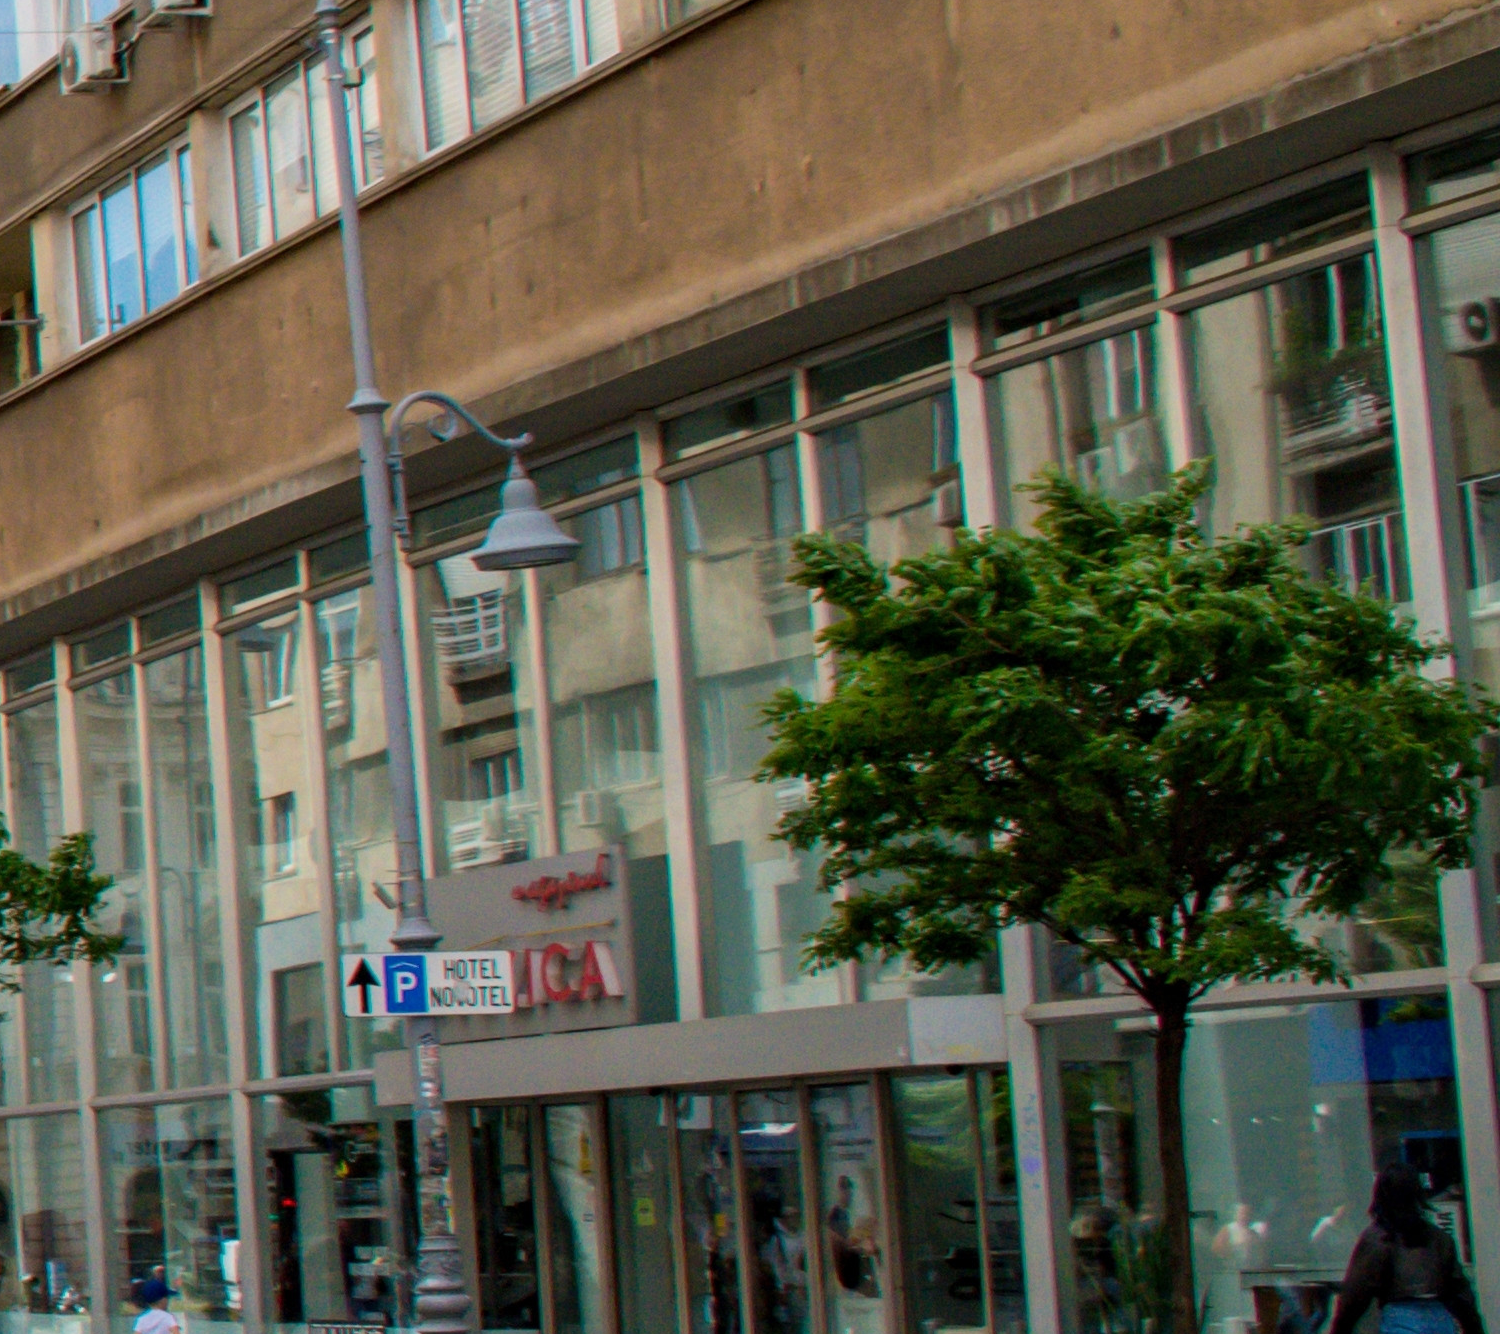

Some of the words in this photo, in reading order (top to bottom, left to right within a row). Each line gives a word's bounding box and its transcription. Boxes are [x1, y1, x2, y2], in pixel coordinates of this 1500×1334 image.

[394, 970, 418, 1004] P
[443, 958, 502, 980] HOTEL
[430, 986, 512, 1008] NOOTEL
[516, 940, 625, 1008] ICA
